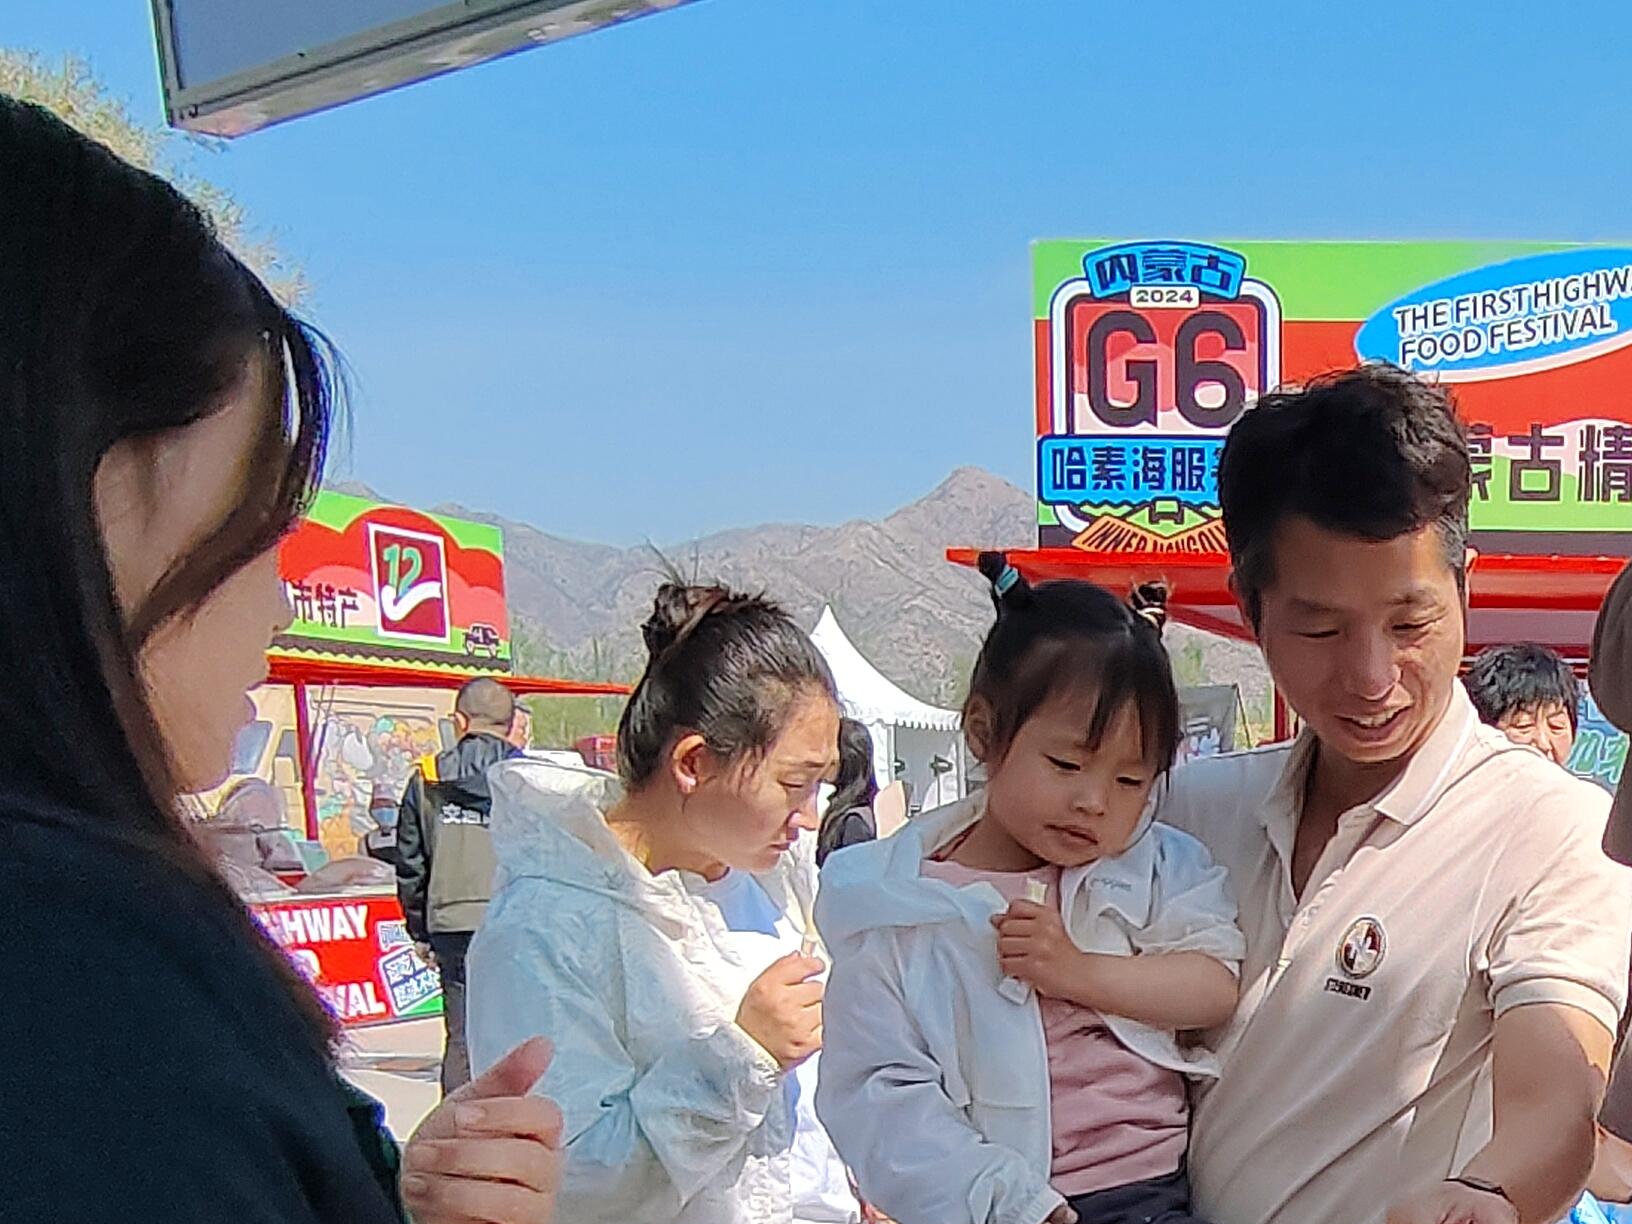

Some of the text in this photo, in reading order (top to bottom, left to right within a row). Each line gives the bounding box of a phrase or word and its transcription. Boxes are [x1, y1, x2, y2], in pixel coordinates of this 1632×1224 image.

[1095, 249, 1238, 292] 内蒙古
[1135, 289, 1194, 304] 2024
[1395, 301, 1450, 334] THE
[1455, 287, 1528, 323] FIRST
[1400, 305, 1615, 366] FOOD FESTIVAL
[1087, 310, 1247, 428] G6
